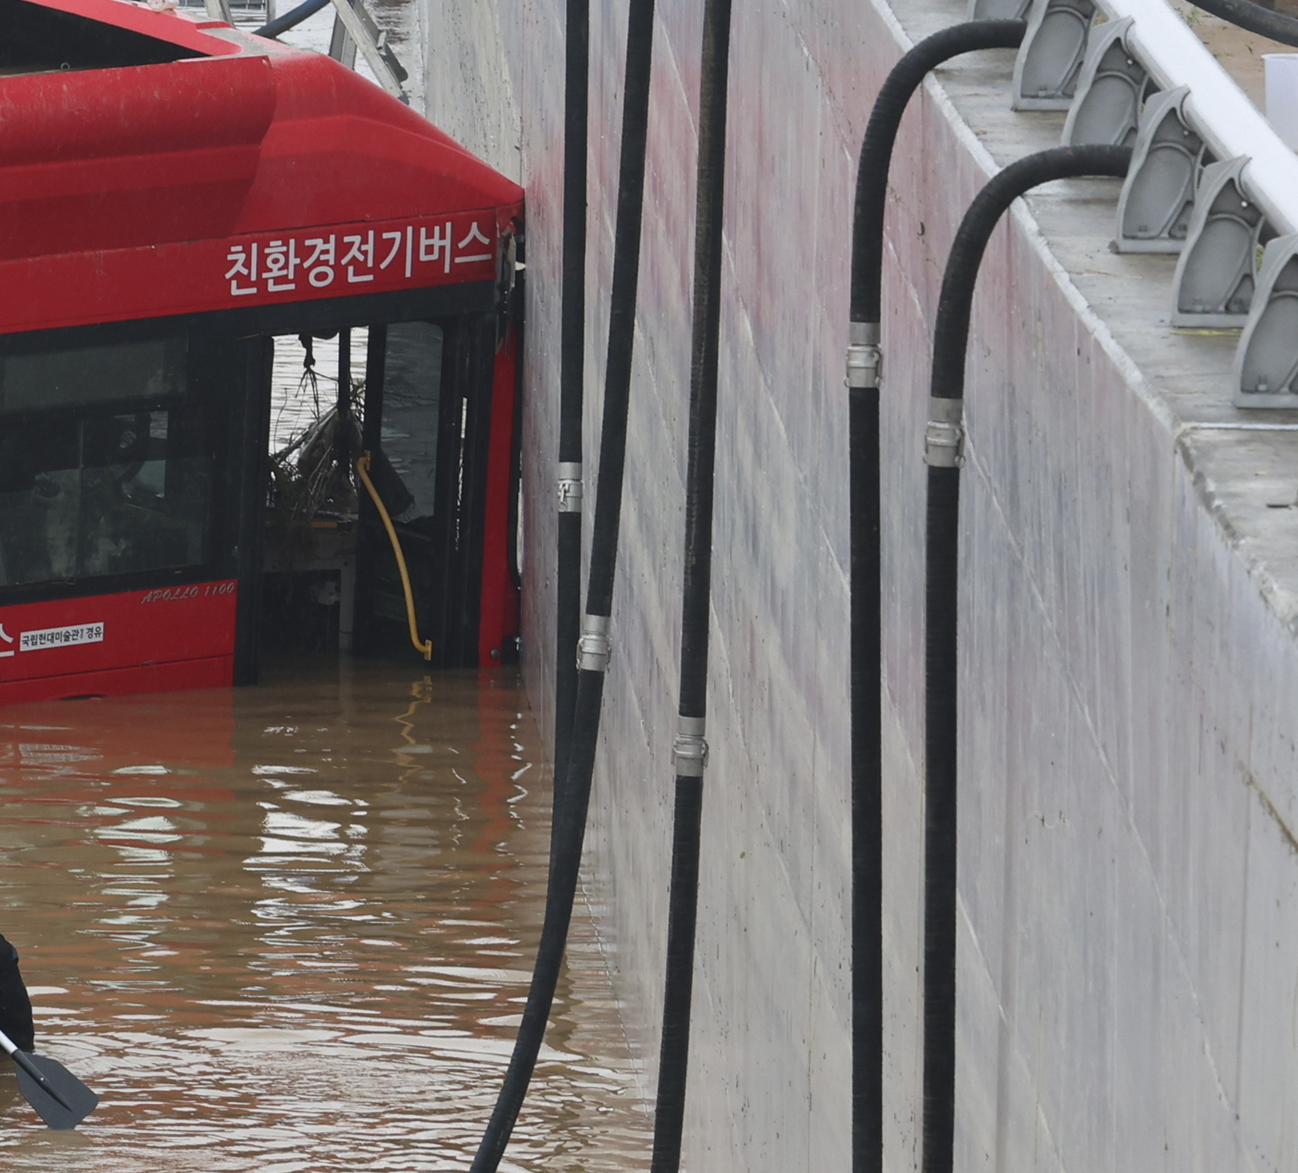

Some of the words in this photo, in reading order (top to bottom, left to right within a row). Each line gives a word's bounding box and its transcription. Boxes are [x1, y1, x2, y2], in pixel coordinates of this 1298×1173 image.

[225, 221, 493, 296] 친환경전기버스
[141, 586, 199, 604] APOLLO
[86, 626, 103, 639] 경유
